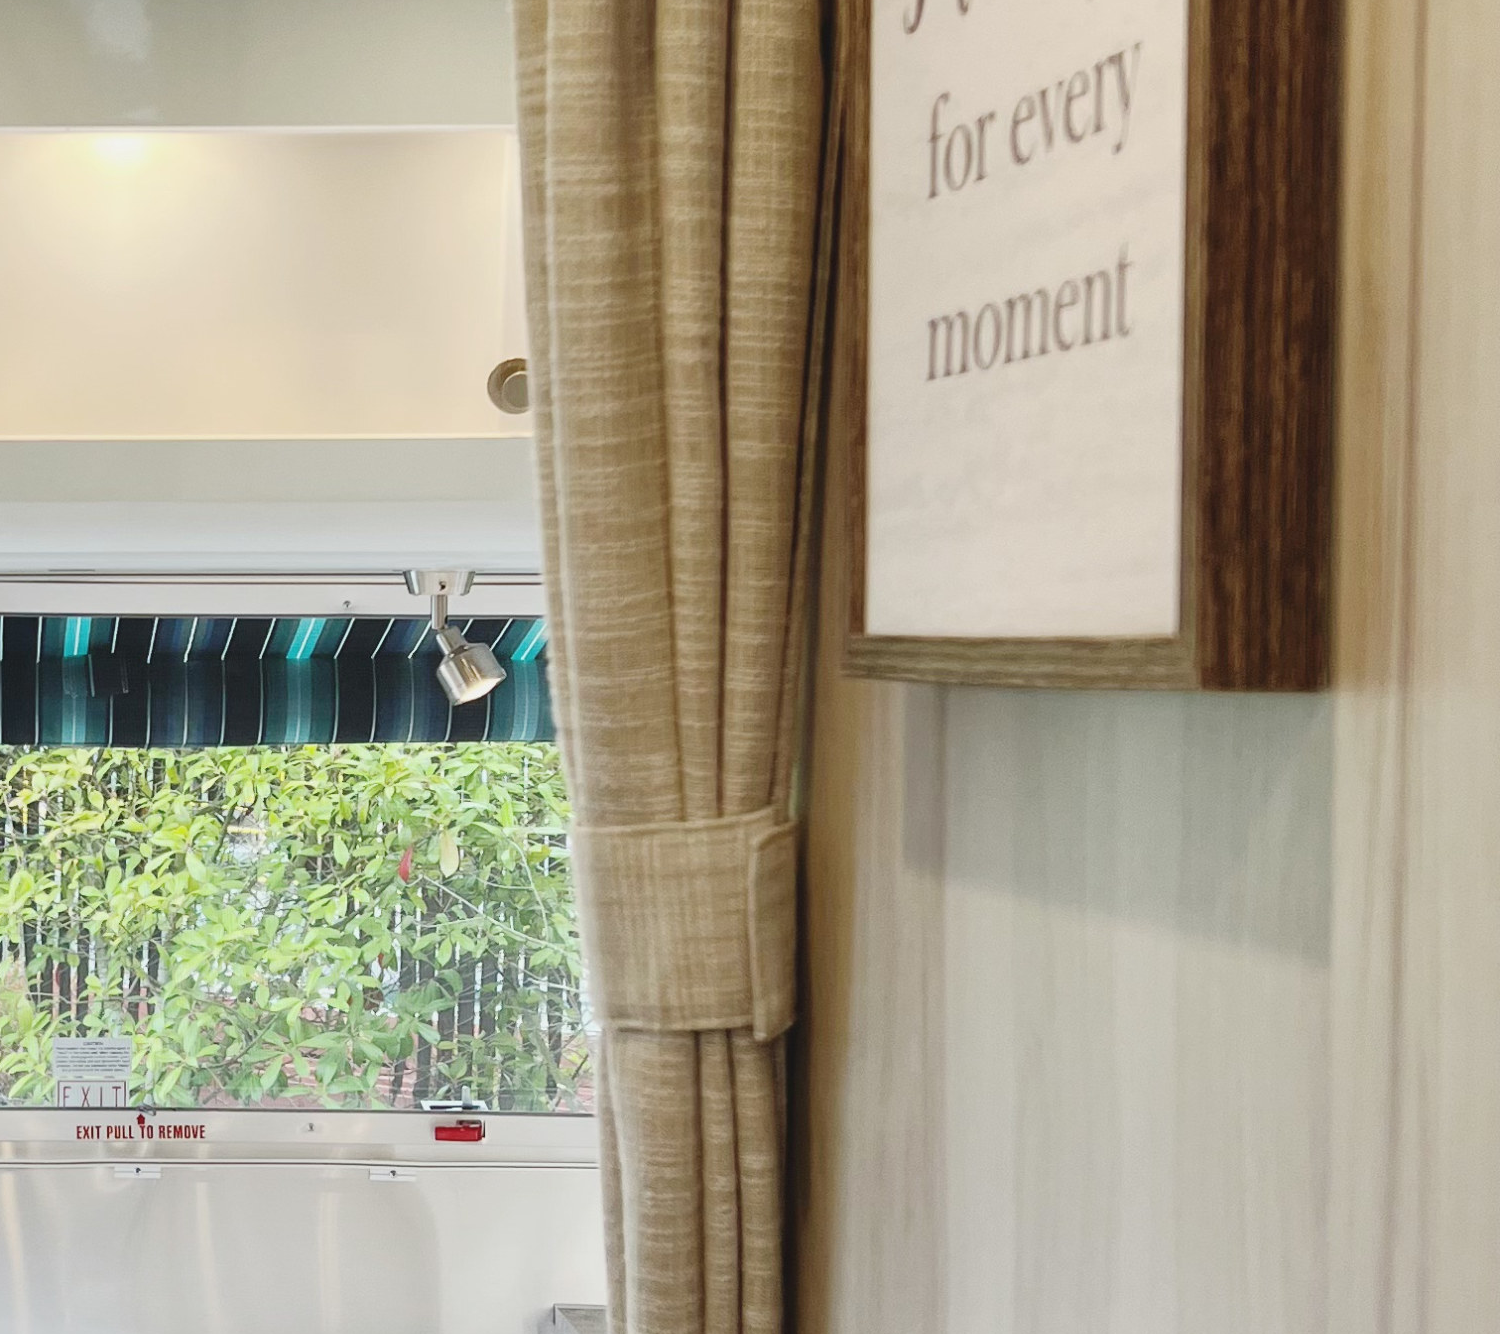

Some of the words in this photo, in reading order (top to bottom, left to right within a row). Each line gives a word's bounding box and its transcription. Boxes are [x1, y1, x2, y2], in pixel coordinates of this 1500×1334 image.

[928, 91, 996, 199] for
[1008, 41, 1143, 166] every
[926, 241, 1132, 382] moment
[63, 1086, 122, 1107] EXIT
[76, 1126, 102, 1140] EXIT
[106, 1126, 135, 1139] PULL
[139, 1125, 154, 1139] TO
[158, 1125, 206, 1139] REMOVE
